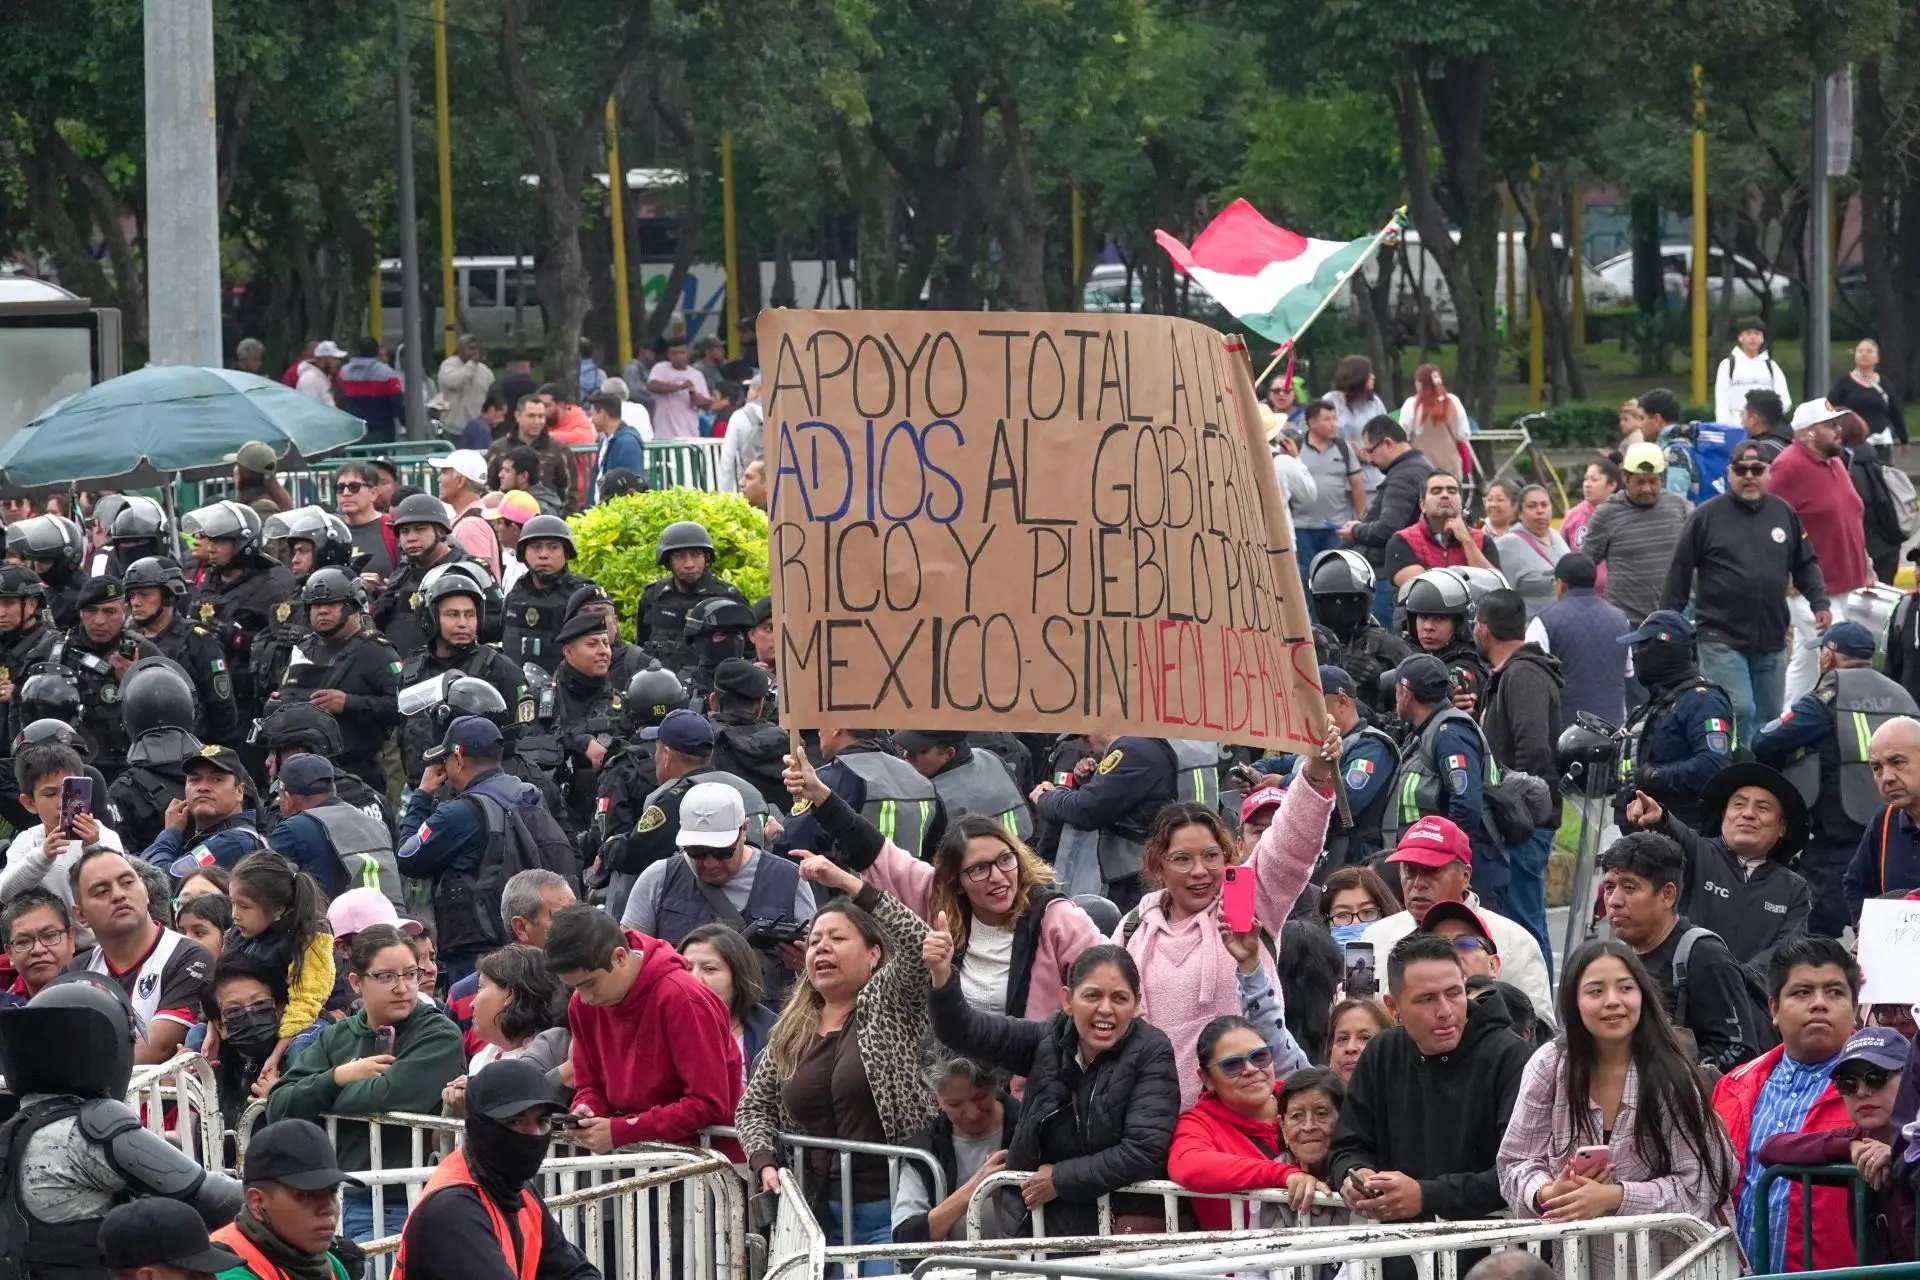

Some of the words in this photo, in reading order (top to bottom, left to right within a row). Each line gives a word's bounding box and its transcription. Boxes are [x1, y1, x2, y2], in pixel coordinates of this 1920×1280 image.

[768, 329, 968, 419] APOYO
[978, 329, 1154, 423] TOTAL
[1170, 324, 1193, 426] A
[769, 418, 966, 524] ADIOS
[982, 418, 1078, 526] AL
[772, 520, 922, 614] RICO
[946, 522, 996, 612] Y
[1027, 526, 1212, 625] PUEBLO
[652, 704, 666, 717] 163
[1703, 880, 1730, 899] STC
